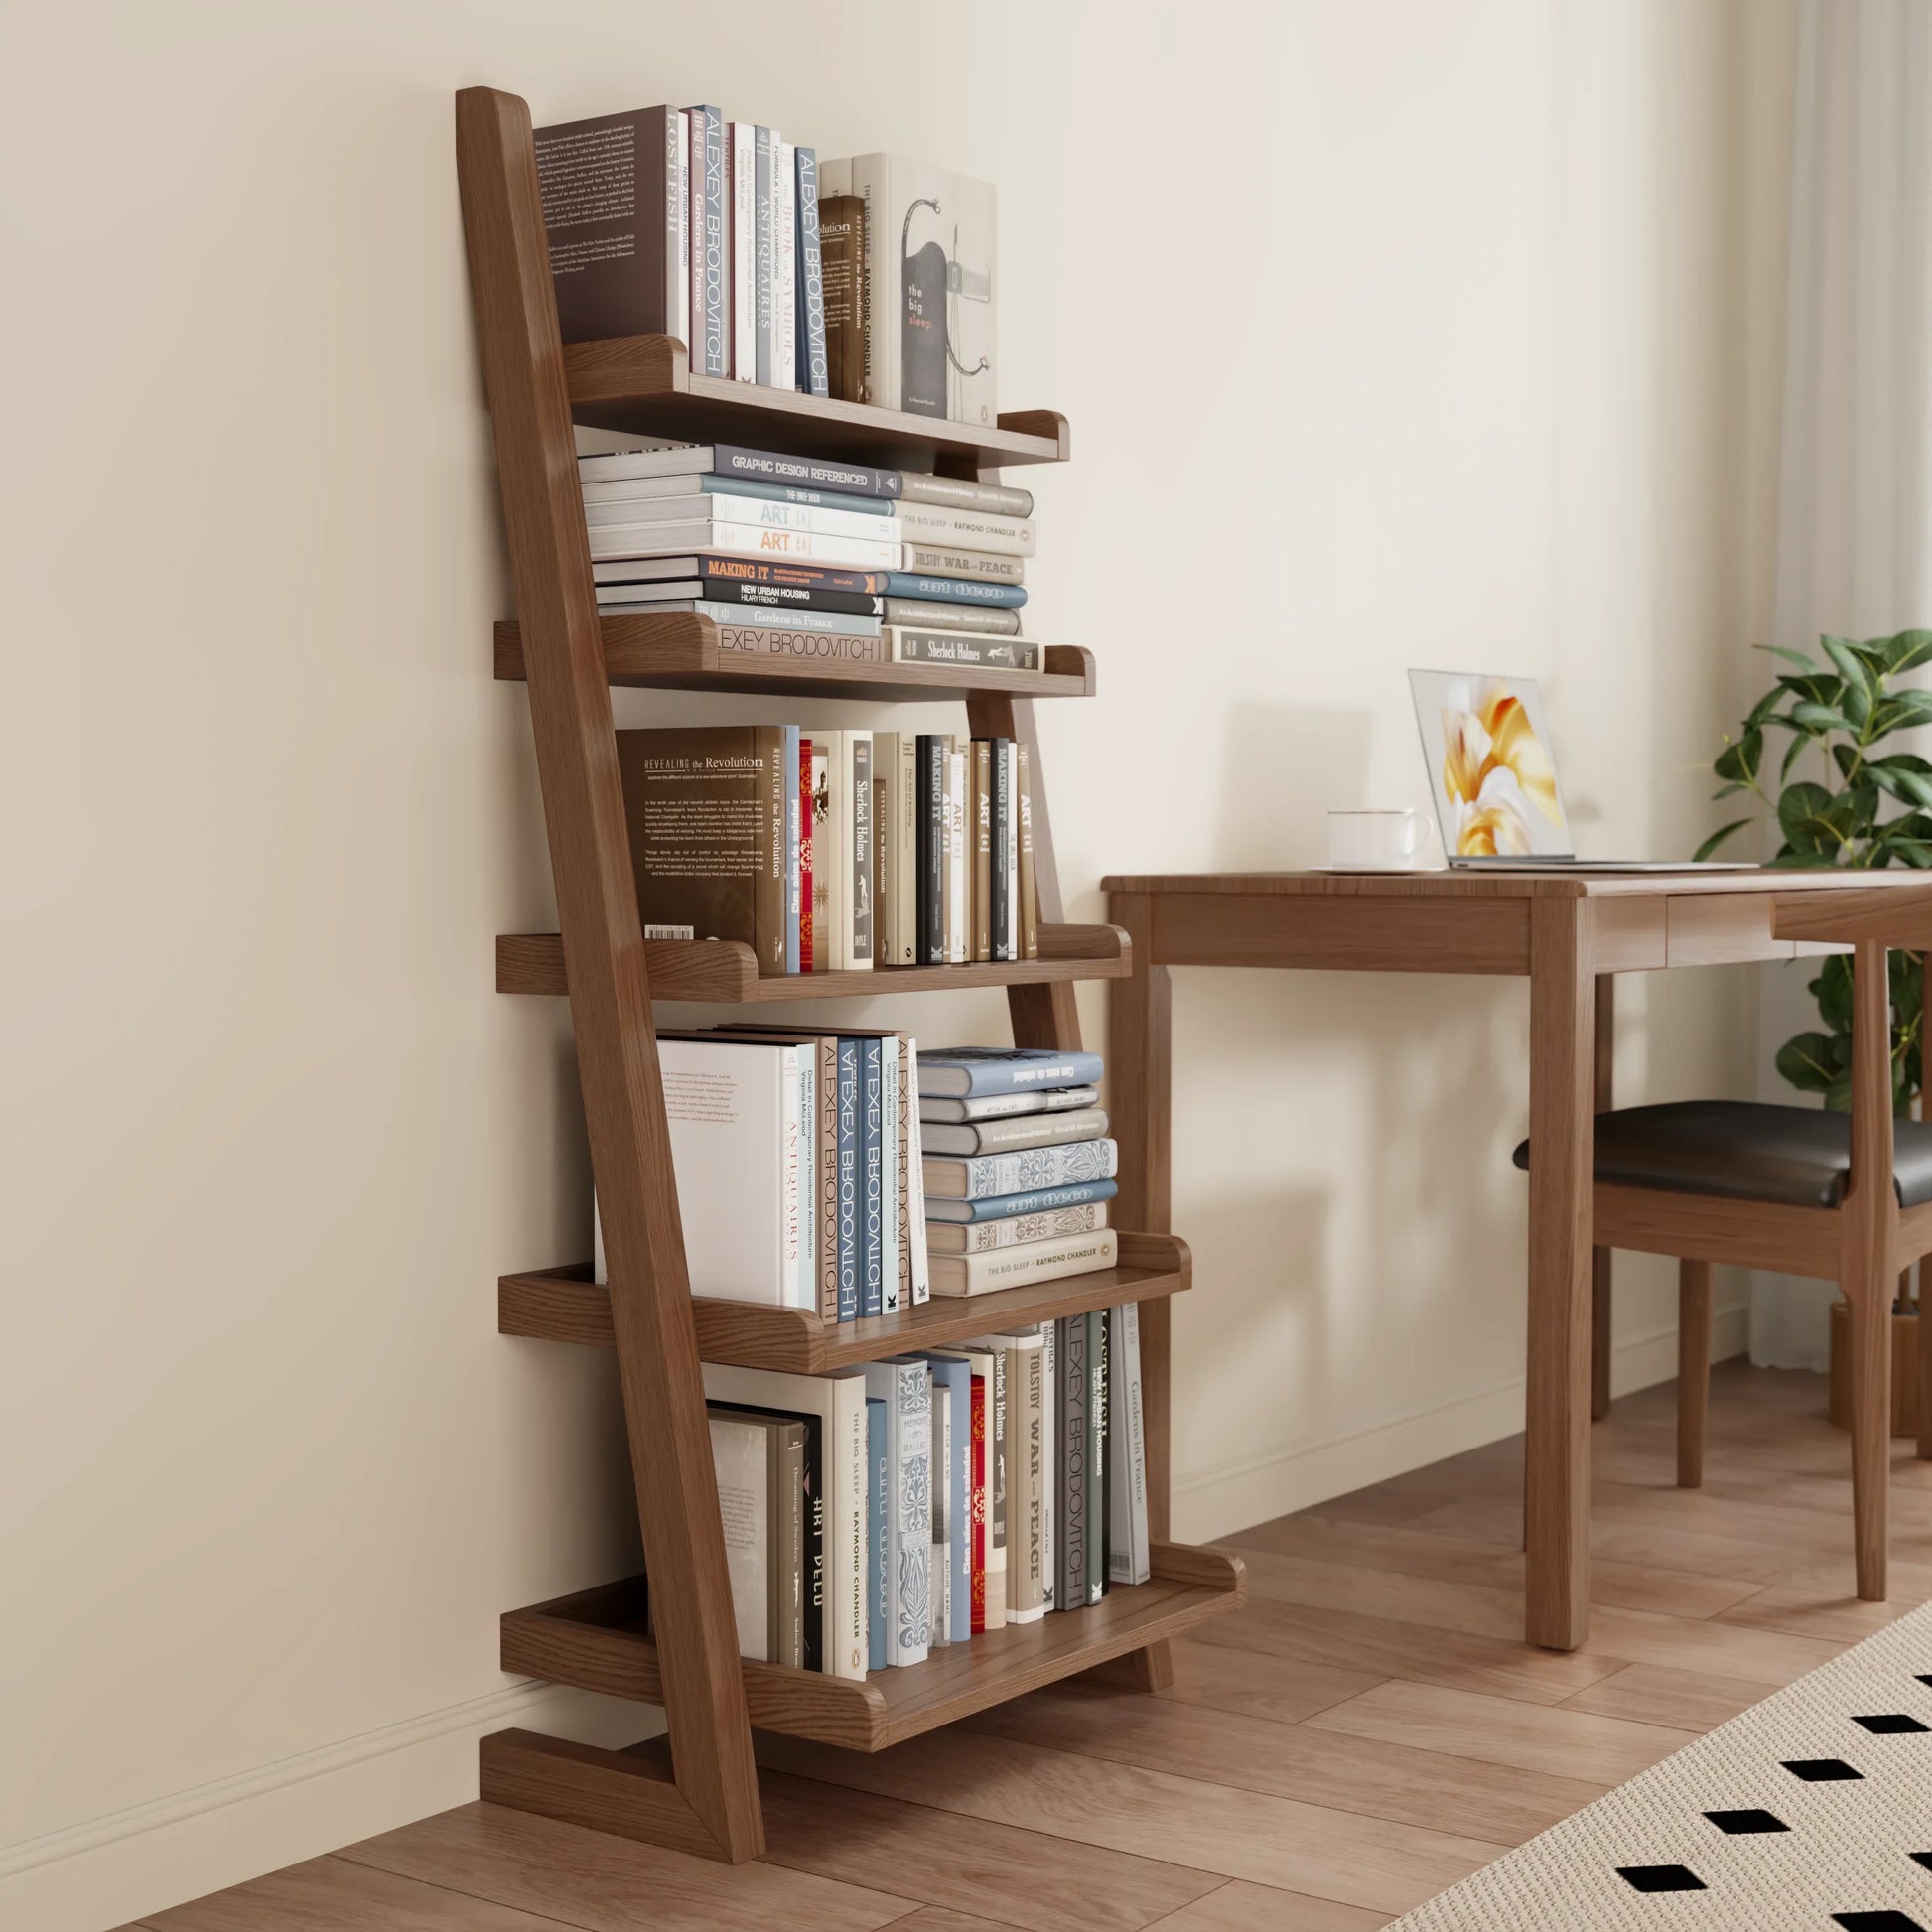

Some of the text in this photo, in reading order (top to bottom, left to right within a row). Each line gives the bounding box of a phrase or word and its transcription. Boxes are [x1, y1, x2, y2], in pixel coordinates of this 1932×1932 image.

[667, 113, 678, 233] LOST FISH
[706, 112, 721, 372] ALEXEY BRODOVITCH
[819, 222, 851, 234] olution
[694, 193, 703, 312] Gardens in France
[759, 195, 770, 329] ANTIQUAIRES
[800, 153, 828, 391] ALEXEY BRODOVITCH
[908, 283, 922, 298] the
[908, 297, 923, 315] big
[909, 313, 931, 332] sleep
[732, 455, 868, 486] GRAPHIC DESIGN REFERENCED
[760, 504, 790, 524] ART
[954, 521, 985, 533] RAYMOND
[986, 526, 1016, 538] CHANDLER
[760, 531, 790, 552] ART
[708, 560, 756, 579] MAKING
[758, 566, 770, 580] IT
[915, 552, 1013, 576] TOLSTOY WAR PEACE
[741, 584, 811, 601] NEW URBAN HOUSING
[741, 594, 779, 605] HILARY FRENCH
[754, 610, 834, 629] Gardens in France
[718, 628, 764, 652] EXEY
[769, 632, 874, 660] BRODOVITCH
[927, 640, 956, 660] Sherlock
[957, 644, 981, 662] Holmes
[644, 759, 690, 770] REVEALING
[692, 759, 703, 769] the
[706, 756, 763, 769] Revolution
[932, 745, 942, 802] MAKING
[998, 748, 1008, 803] MAKING
[856, 780, 869, 862] Sherlock Holmes
[932, 806, 942, 821] IT
[954, 804, 963, 835] ART
[980, 793, 990, 828] ART
[998, 806, 1008, 821] IT
[1020, 794, 1032, 828] ART
[773, 818, 782, 878] Revolution
[825, 1045, 837, 1307] ALEXEY BRODOVITCH
[898, 1139, 908, 1292] BRODOVITCH
[988, 1248, 1096, 1277] THE BIG SLEEP RAYMOND CHANDLER
[996, 1352, 1006, 1441] Sherlock Holmes
[1131, 1381, 1144, 1506] Gardens in France
[1030, 1352, 1040, 1581] TOLSTOY WAR PEACE
[1069, 1417, 1083, 1589] BRODOVITCH
